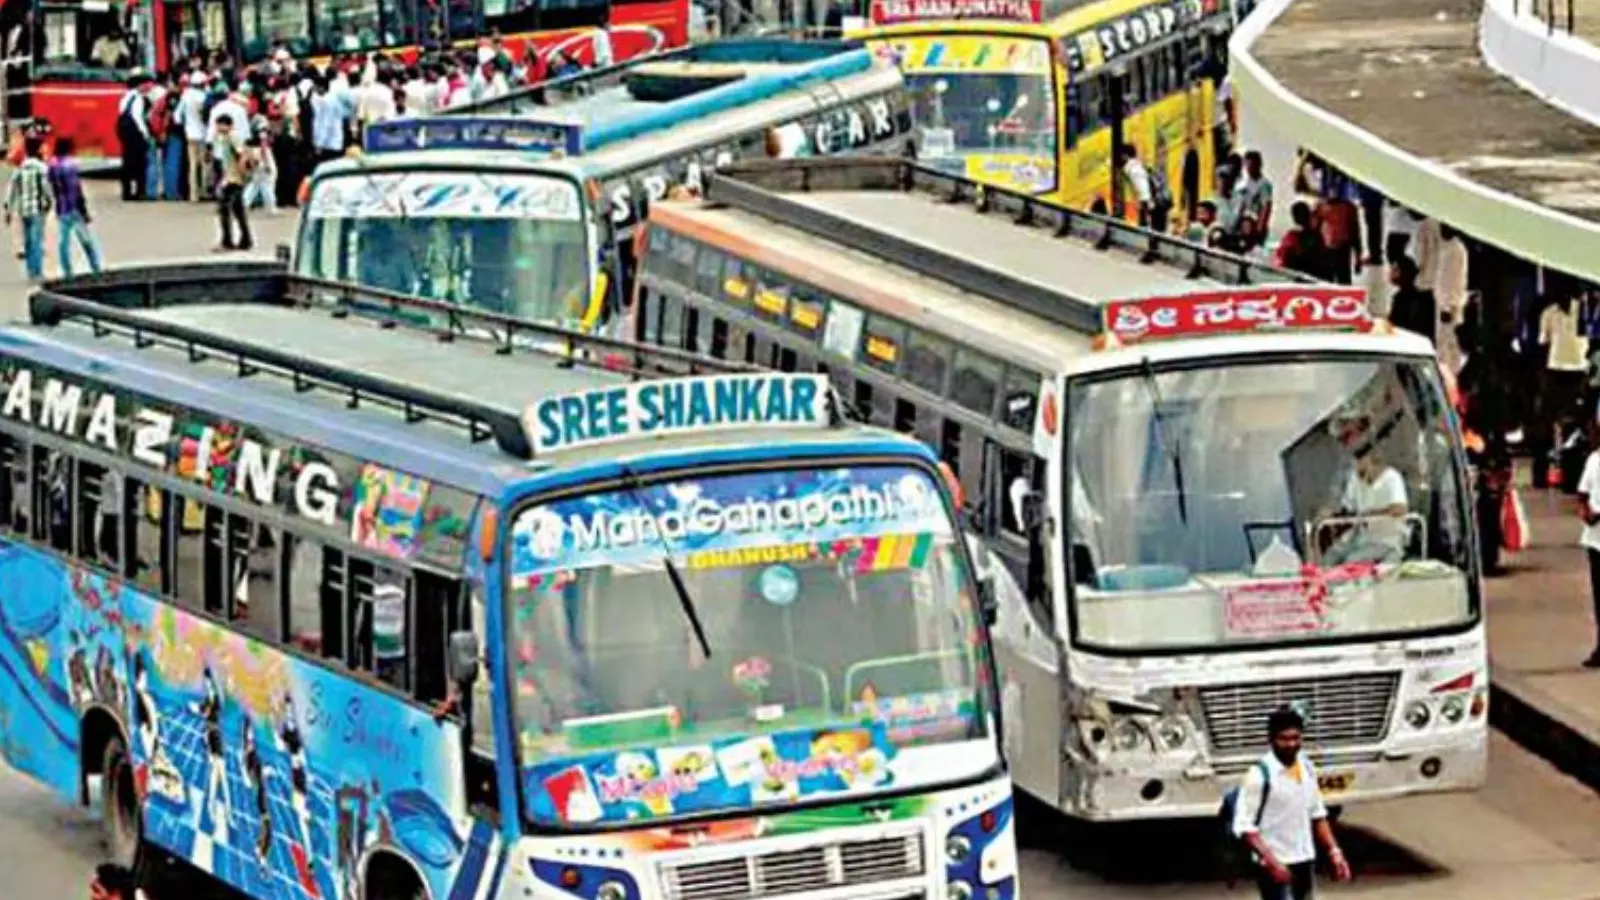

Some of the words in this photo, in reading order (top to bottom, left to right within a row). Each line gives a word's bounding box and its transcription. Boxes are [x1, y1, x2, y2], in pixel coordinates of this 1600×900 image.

[5, 370, 341, 526] AMAZING
[537, 388, 628, 447] SREE
[637, 377, 818, 430] SHANKAR
